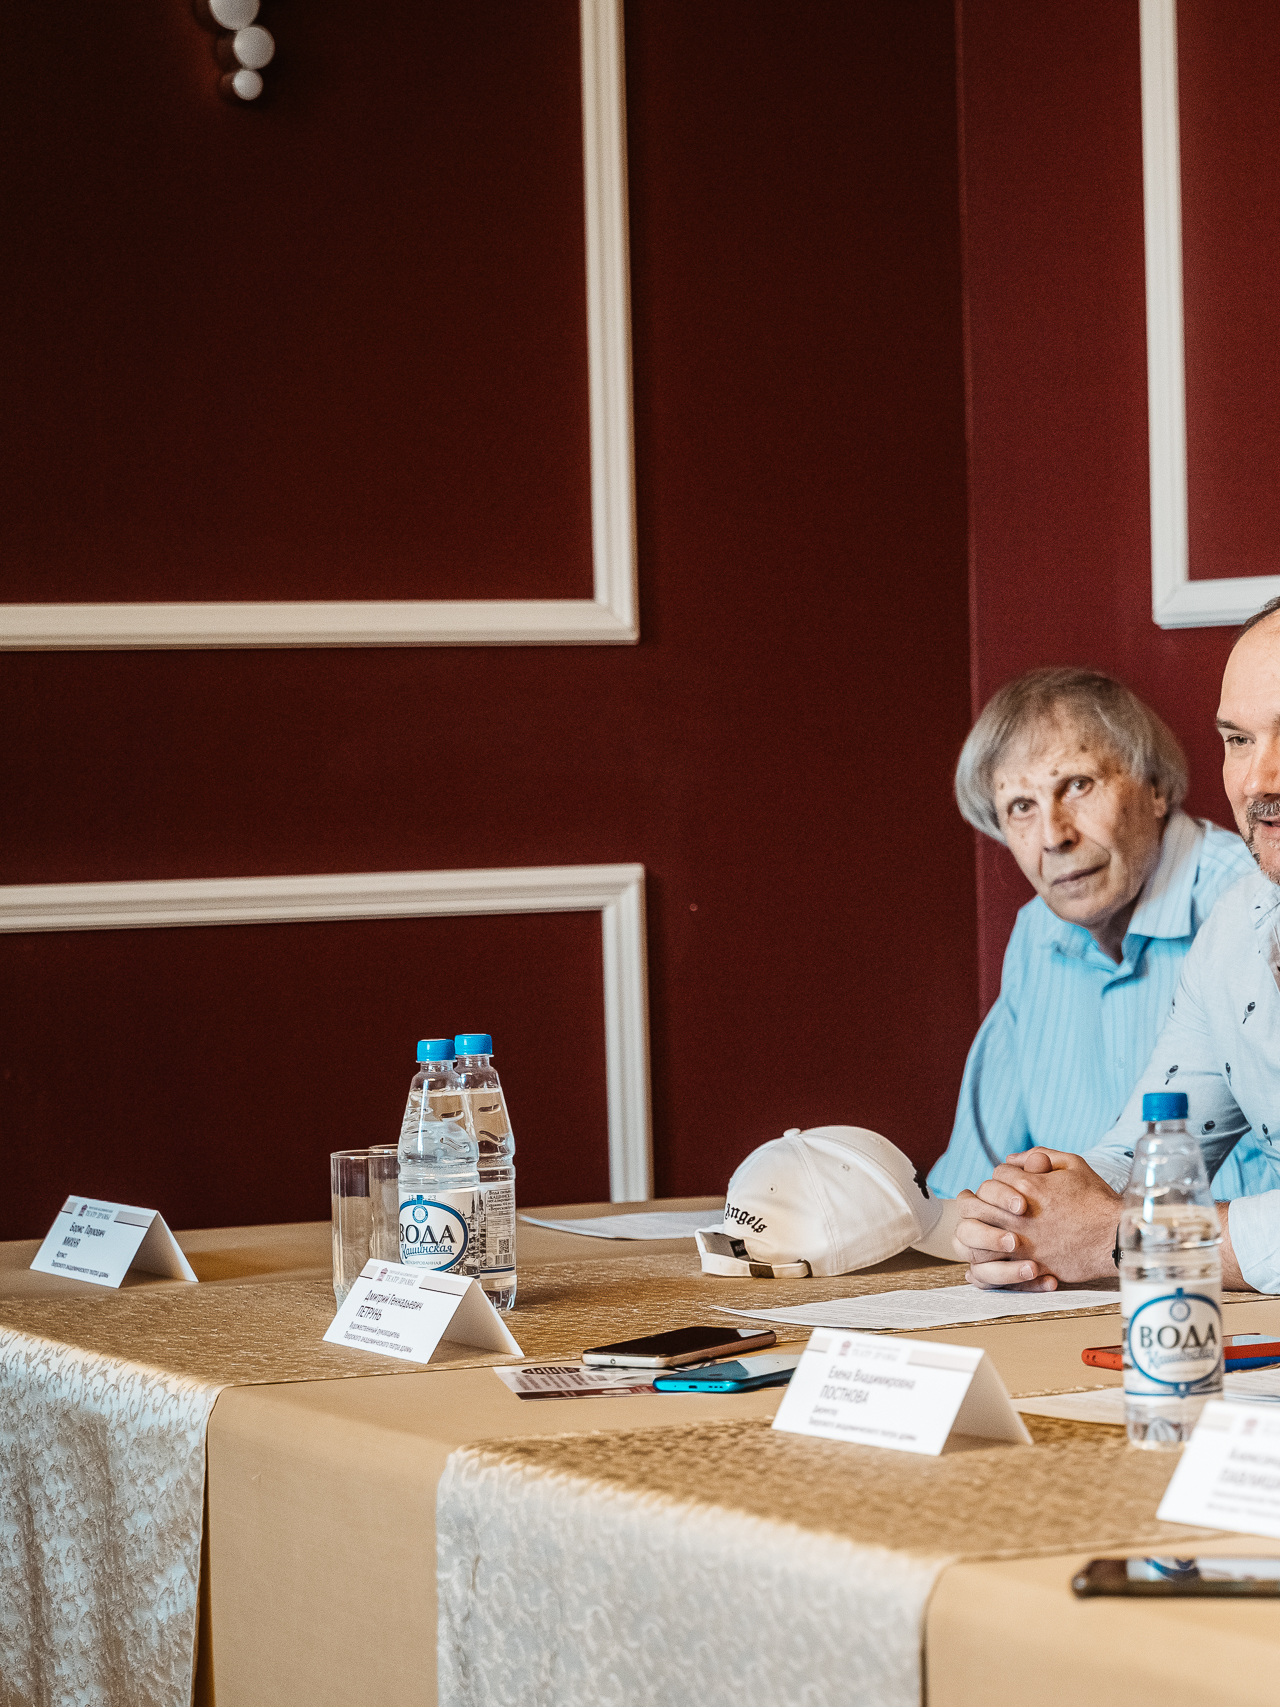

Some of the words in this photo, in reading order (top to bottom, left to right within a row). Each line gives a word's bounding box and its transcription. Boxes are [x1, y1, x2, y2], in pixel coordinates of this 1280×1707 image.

[69, 1221, 85, 1234] Борис
[364, 1289, 391, 1305] Дмитрий
[388, 1293, 424, 1312] Геннадьевич
[355, 1305, 383, 1321] ПЕТРУНЬ
[1140, 1323, 1218, 1349] ВОДА
[828, 1365, 853, 1381] Елена
[853, 1368, 916, 1390] Владимировна
[820, 1384, 870, 1404] ПОСТНОВА
